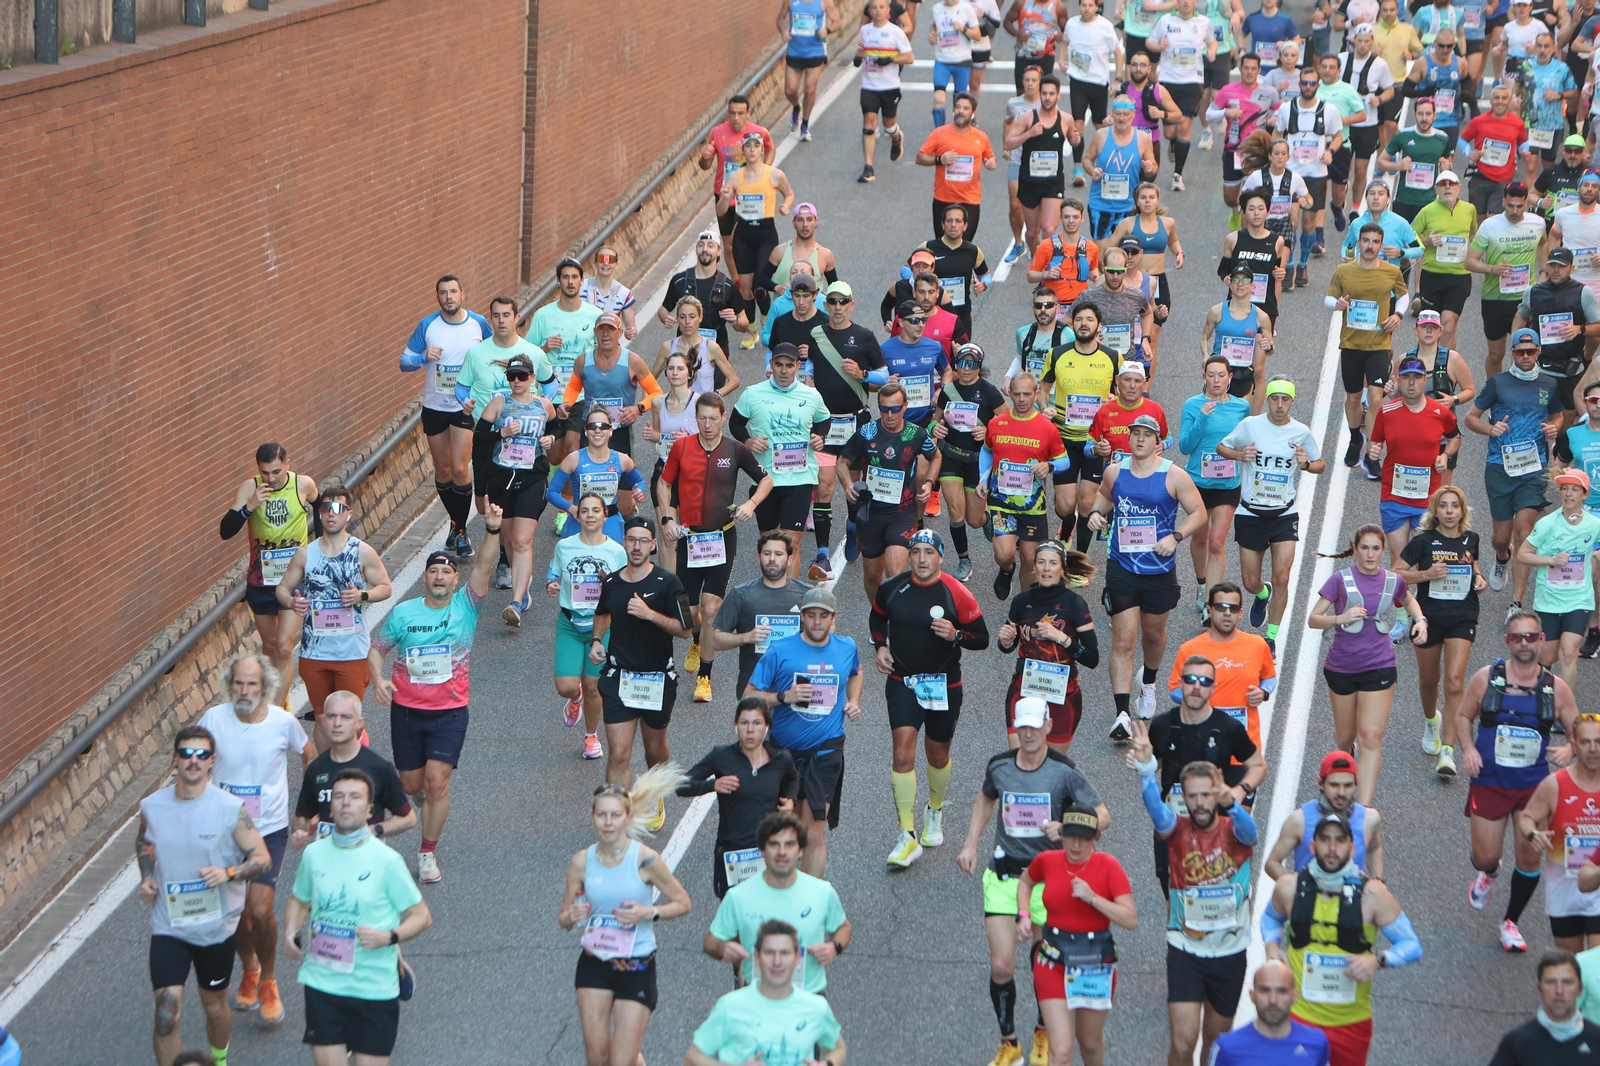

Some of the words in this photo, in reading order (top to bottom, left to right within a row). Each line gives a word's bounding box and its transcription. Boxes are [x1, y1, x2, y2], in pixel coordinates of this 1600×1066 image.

[996, 435, 1040, 448] INDEPENDIENTES
[879, 470, 900, 478] ZURICH
[266, 500, 287, 514] ROCK
[1131, 505, 1160, 514] mind
[269, 515, 287, 526] RUN
[1038, 677, 1052, 685] 9100
[740, 851, 761, 860] ZURIC
[740, 866, 758, 874] 10770
[323, 927, 350, 937] ZURICH
